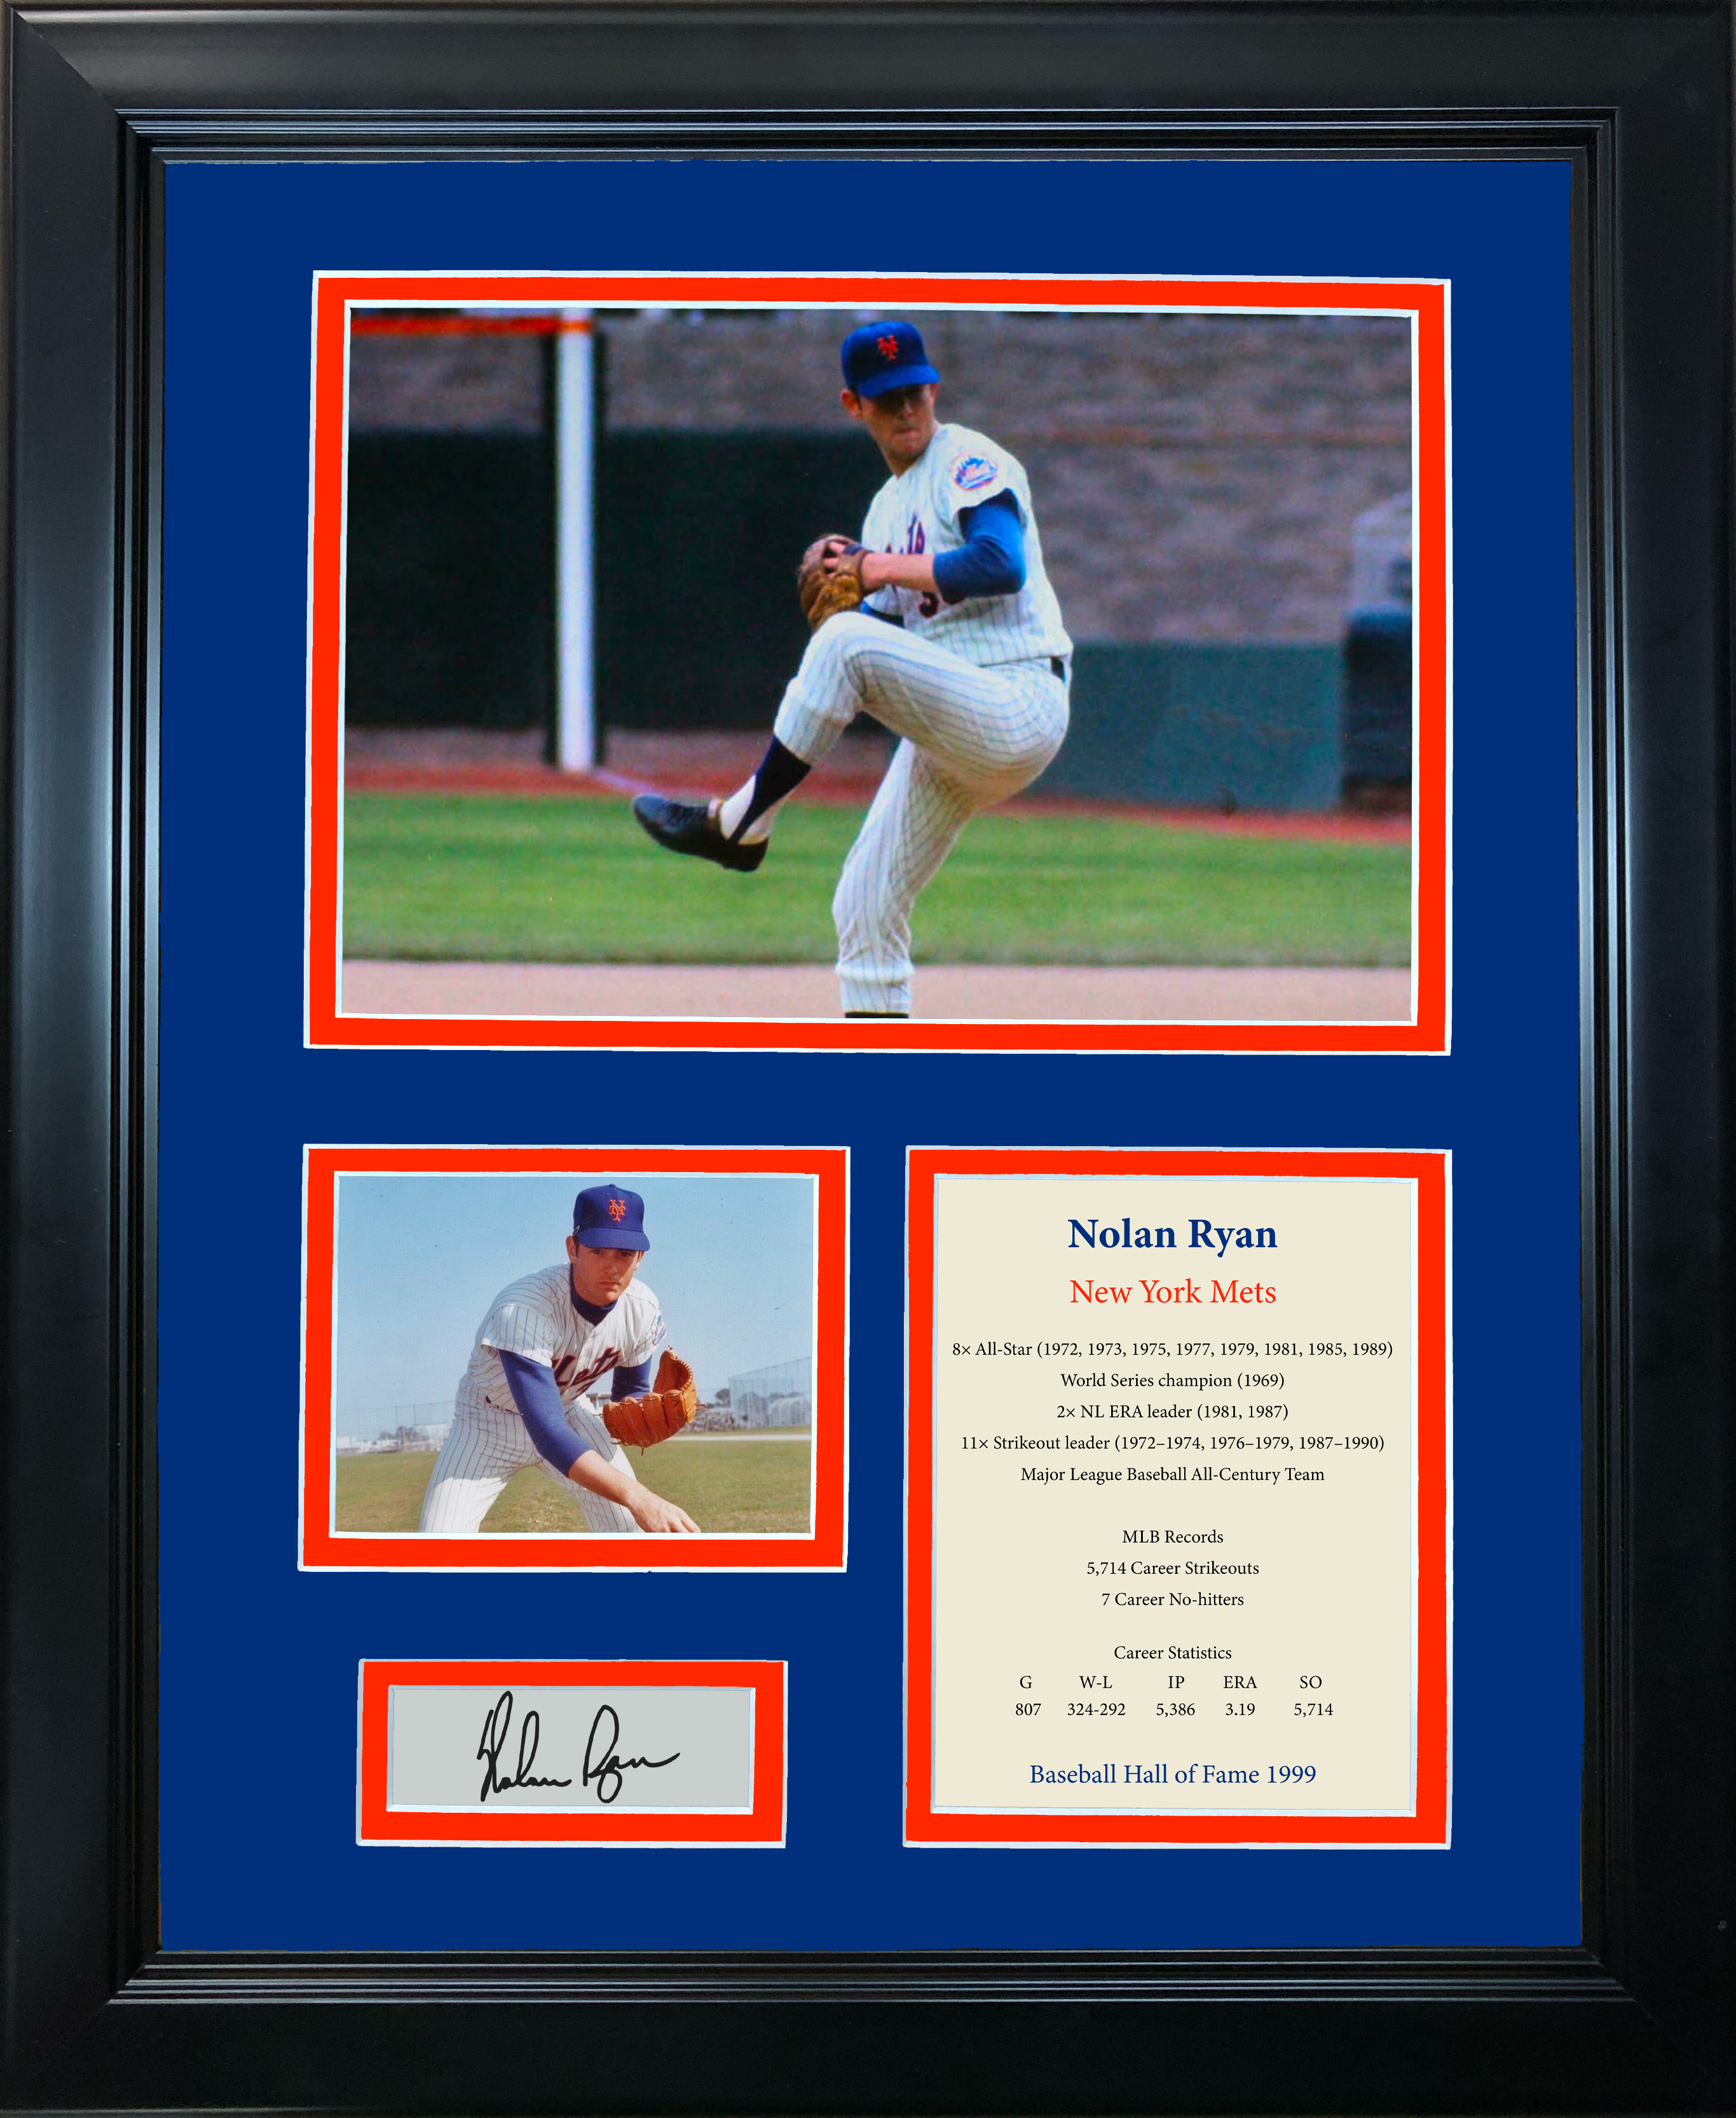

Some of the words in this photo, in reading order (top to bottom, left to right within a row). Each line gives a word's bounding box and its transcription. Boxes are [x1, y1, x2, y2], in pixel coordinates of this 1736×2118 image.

[609, 1199, 626, 1222] NY
[1068, 1217, 1177, 1248] Nolan
[1188, 1220, 1278, 1257] Ryan
[1070, 1280, 1133, 1303] New
[1138, 1278, 1203, 1303] York
[1210, 1280, 1276, 1303] Mets
[975, 1342, 1032, 1355] All-Star
[1037, 1341, 1081, 1358] (1972,
[1089, 1343, 1126, 1357] 1973,
[1133, 1343, 1170, 1357] 1975,
[1177, 1343, 1214, 1357] 1977,
[1221, 1343, 1258, 1357] 1979,
[1265, 1343, 1302, 1357] 1981,
[1309, 1343, 1346, 1357] 1985,
[1353, 1341, 1392, 1358] 1989)
[1060, 1373, 1106, 1386] World
[1111, 1374, 1154, 1386] Series
[1159, 1373, 1232, 1391] champion
[1238, 1373, 1284, 1390] (1969)
[1057, 1405, 1075, 1418] 2×
[1081, 1405, 1104, 1418] NL
[1109, 1405, 1144, 1418] ERA
[1147, 1404, 1192, 1418] leader
[1198, 1404, 1242, 1421] (1981,
[1248, 1404, 1288, 1421] 1987)
[962, 1437, 988, 1449] 11×
[994, 1435, 1060, 1449] Strikeout
[1065, 1435, 1110, 1449] leader
[1021, 1468, 1065, 1485] Major
[1070, 1468, 1122, 1485] League
[1127, 1467, 1187, 1480] Baseball
[1191, 1467, 1281, 1485] All-Century
[1285, 1468, 1325, 1480] Team
[1123, 1531, 1159, 1543] MLB
[1165, 1529, 1223, 1543] Records
[1087, 1562, 1126, 1576] 5,714
[1131, 1562, 1180, 1575] Career
[1186, 1561, 1259, 1575] Strikeouts
[1102, 1594, 1110, 1605] 7
[1115, 1593, 1165, 1606] Career
[1169, 1592, 1243, 1606] No-hitters
[1114, 1646, 1164, 1659] Career
[1168, 1646, 1231, 1659] Statistics
[1020, 1676, 1032, 1688] G
[1079, 1676, 1112, 1688] W-L
[1168, 1676, 1184, 1688] IP
[1224, 1676, 1257, 1688] ERA
[1300, 1676, 1322, 1688] SO
[1016, 1704, 1041, 1716] 807
[1068, 1704, 1125, 1716] 324-292
[1156, 1703, 1195, 1718] 5,386
[1226, 1704, 1255, 1716] 3.19
[1294, 1704, 1333, 1717] 5,714
[1030, 1764, 1116, 1783] Baseball
[1124, 1764, 1168, 1783] Hall
[1175, 1763, 1198, 1783] of
[1203, 1765, 1259, 1783] Fame
[1268, 1766, 1316, 1783] 1999
